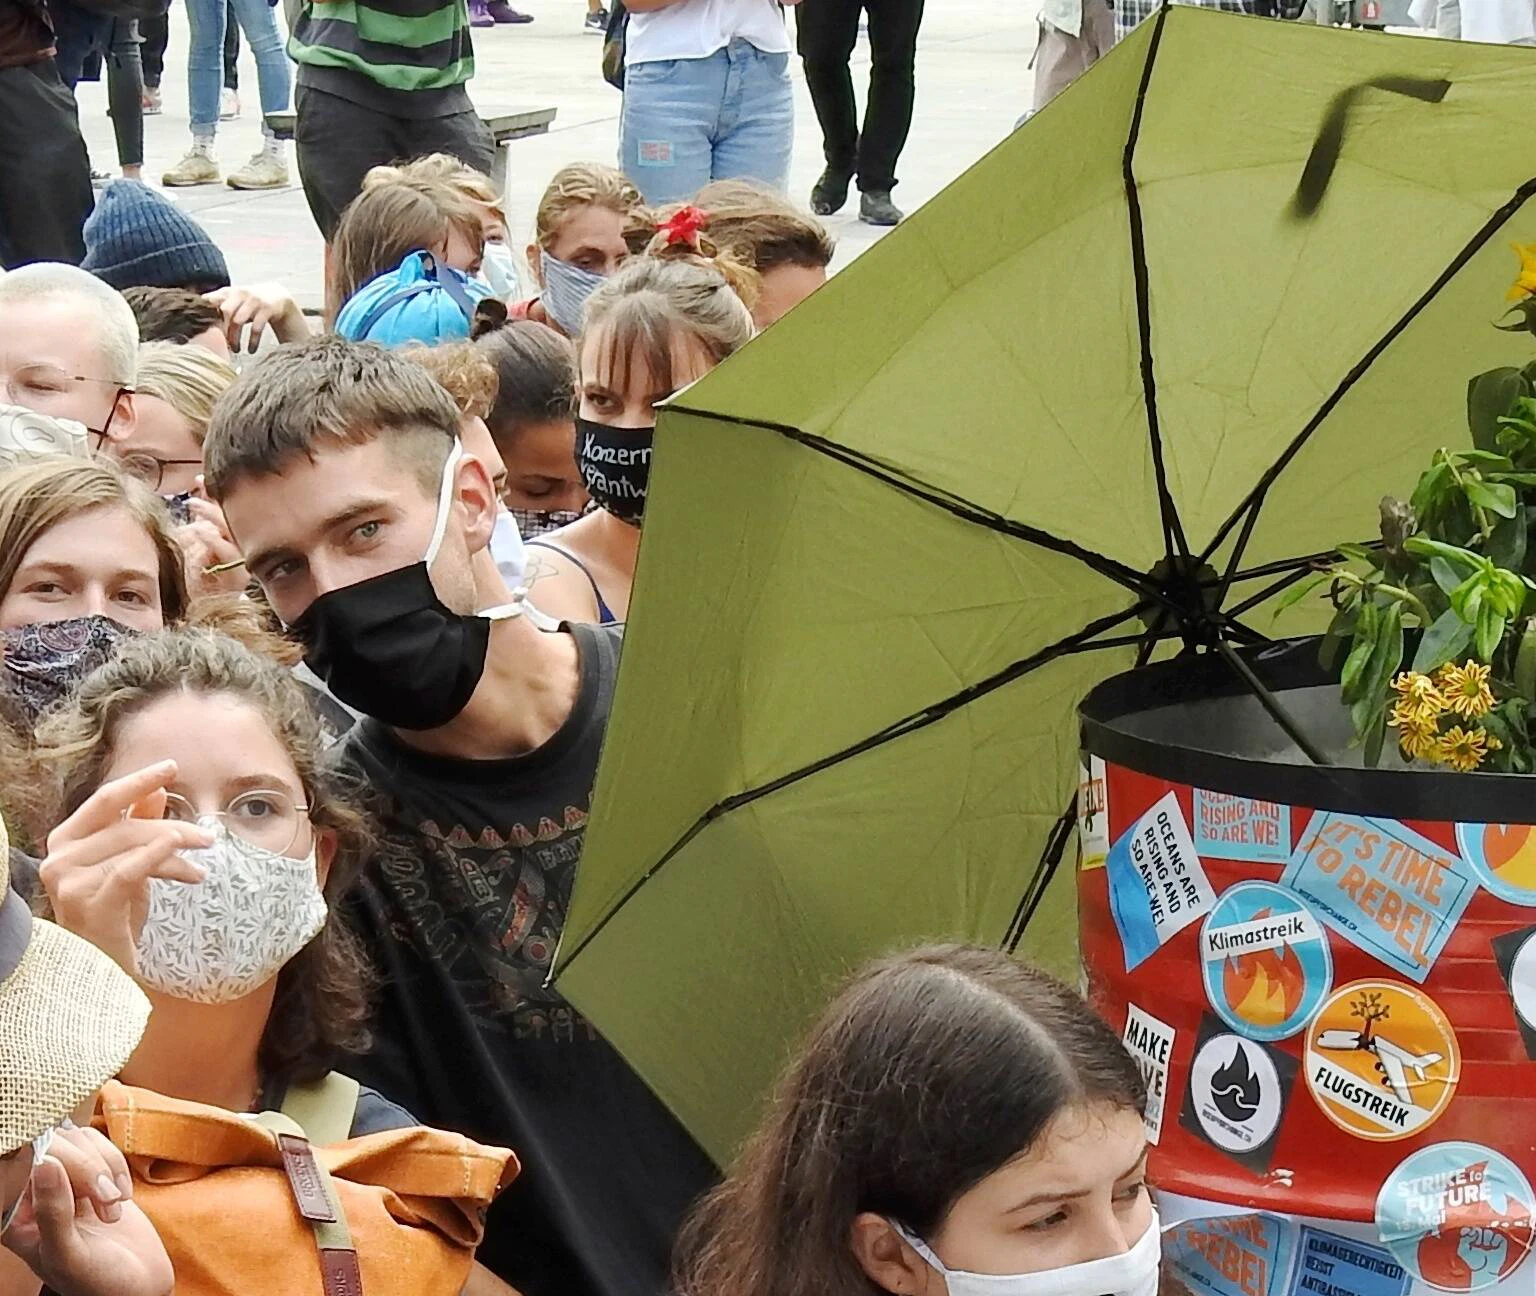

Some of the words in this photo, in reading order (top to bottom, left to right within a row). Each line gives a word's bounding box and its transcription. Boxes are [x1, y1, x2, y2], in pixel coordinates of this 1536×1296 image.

[582, 432, 654, 466] Konzern
[1200, 804, 1245, 826] RISING
[1200, 826, 1218, 841] SO
[1221, 824, 1250, 845] ARE
[1252, 821, 1281, 846] WE!
[1131, 838, 1145, 863] SO
[1138, 863, 1157, 897] ARE
[1149, 891, 1166, 928] WE!
[1143, 826, 1169, 881] RISING
[1162, 877, 1182, 915] AND
[1156, 811, 1186, 877] OCEANS
[1180, 870, 1201, 909] ARE
[1323, 820, 1381, 861] IT'S
[1379, 840, 1452, 908] TIME
[1302, 834, 1344, 875] TO
[1337, 863, 1431, 969] REBEL
[1208, 916, 1306, 952] Klimastreik
[1126, 1017, 1170, 1065] MAKE
[1314, 1066, 1410, 1127] FLUGSTREIK
[1395, 1167, 1467, 1198] STRIKE
[1406, 1181, 1493, 1215] FUTURE
